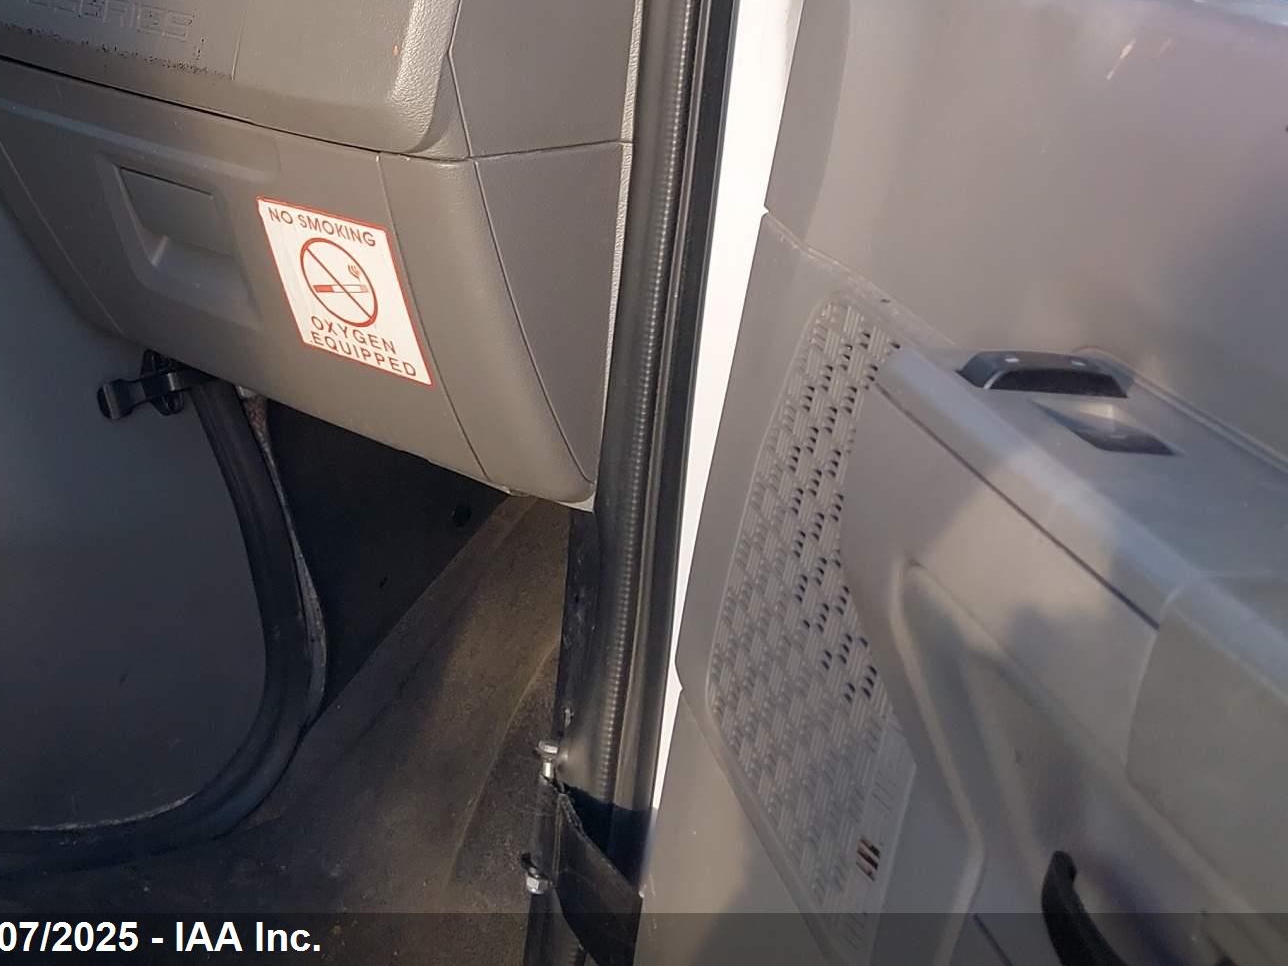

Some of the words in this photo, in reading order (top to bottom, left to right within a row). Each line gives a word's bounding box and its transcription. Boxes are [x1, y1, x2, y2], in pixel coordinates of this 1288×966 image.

[268, 207, 293, 225] NO
[298, 214, 376, 247] SMOKING
[310, 331, 417, 376] EQUIPPED
[311, 316, 396, 354] OXYGEN
